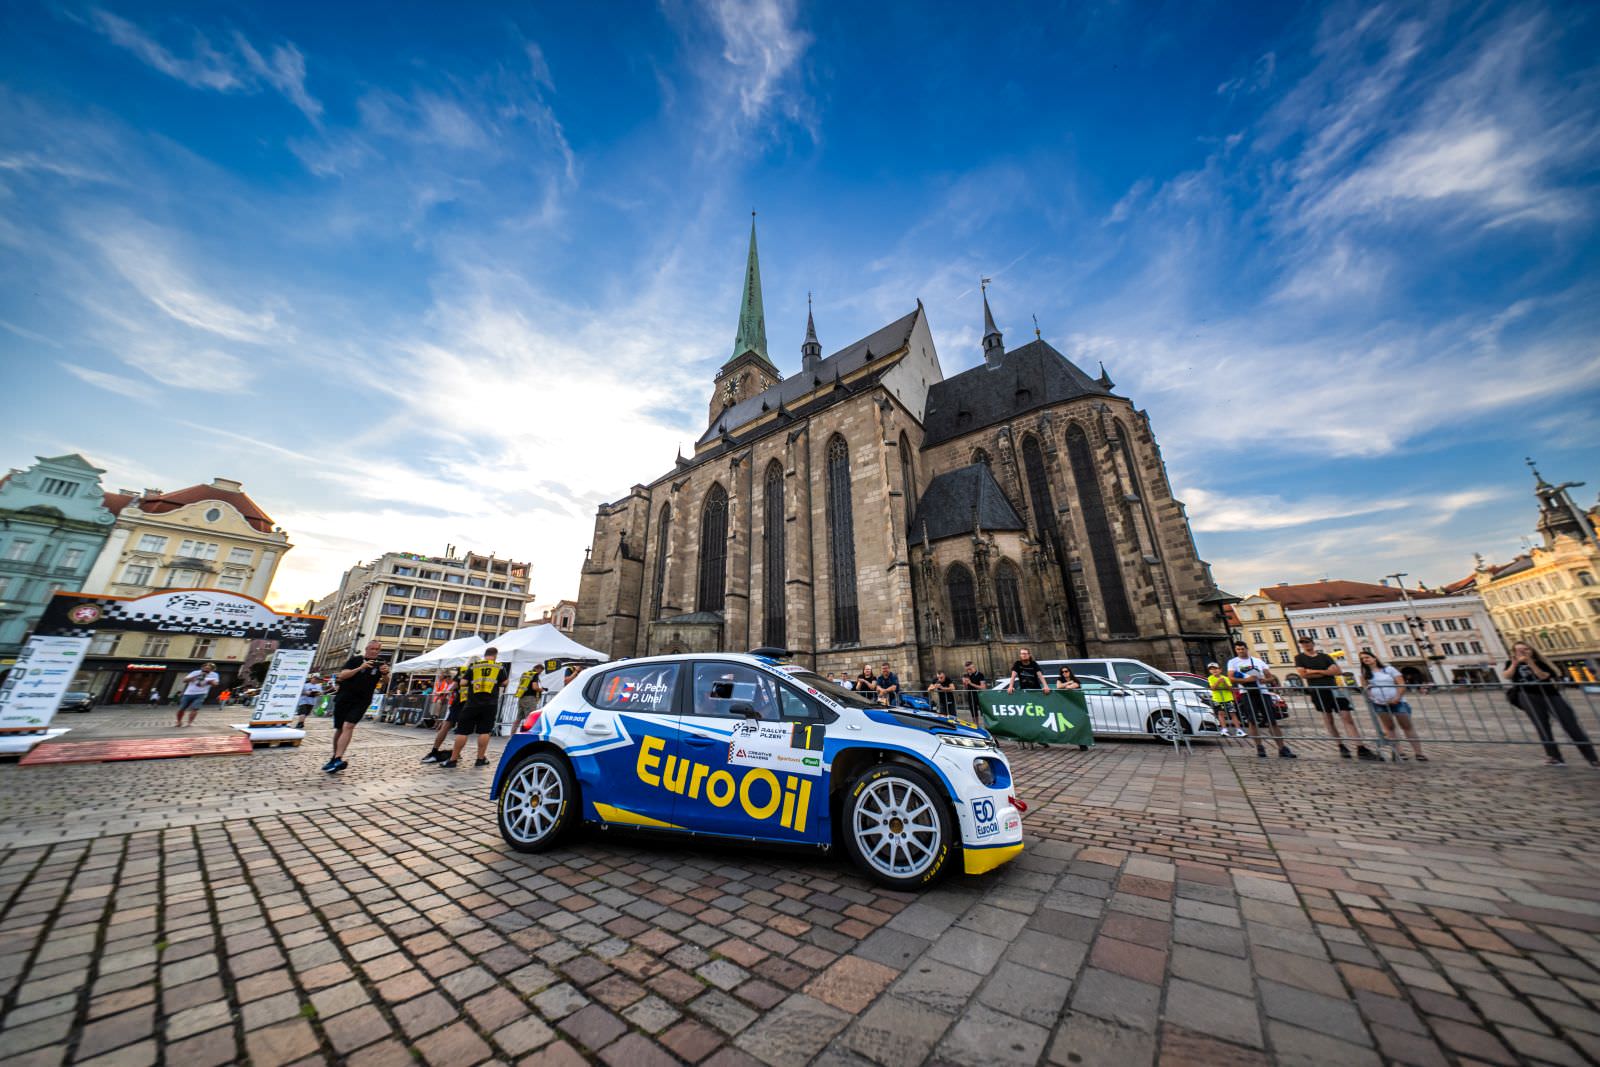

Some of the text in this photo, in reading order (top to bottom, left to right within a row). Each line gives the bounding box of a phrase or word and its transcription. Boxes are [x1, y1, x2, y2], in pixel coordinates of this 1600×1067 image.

[188, 625, 247, 637] Racing
[252, 674, 279, 721] Racing
[741, 725, 757, 733] RP
[804, 725, 812, 750] 1
[636, 735, 812, 833] EuroOil
